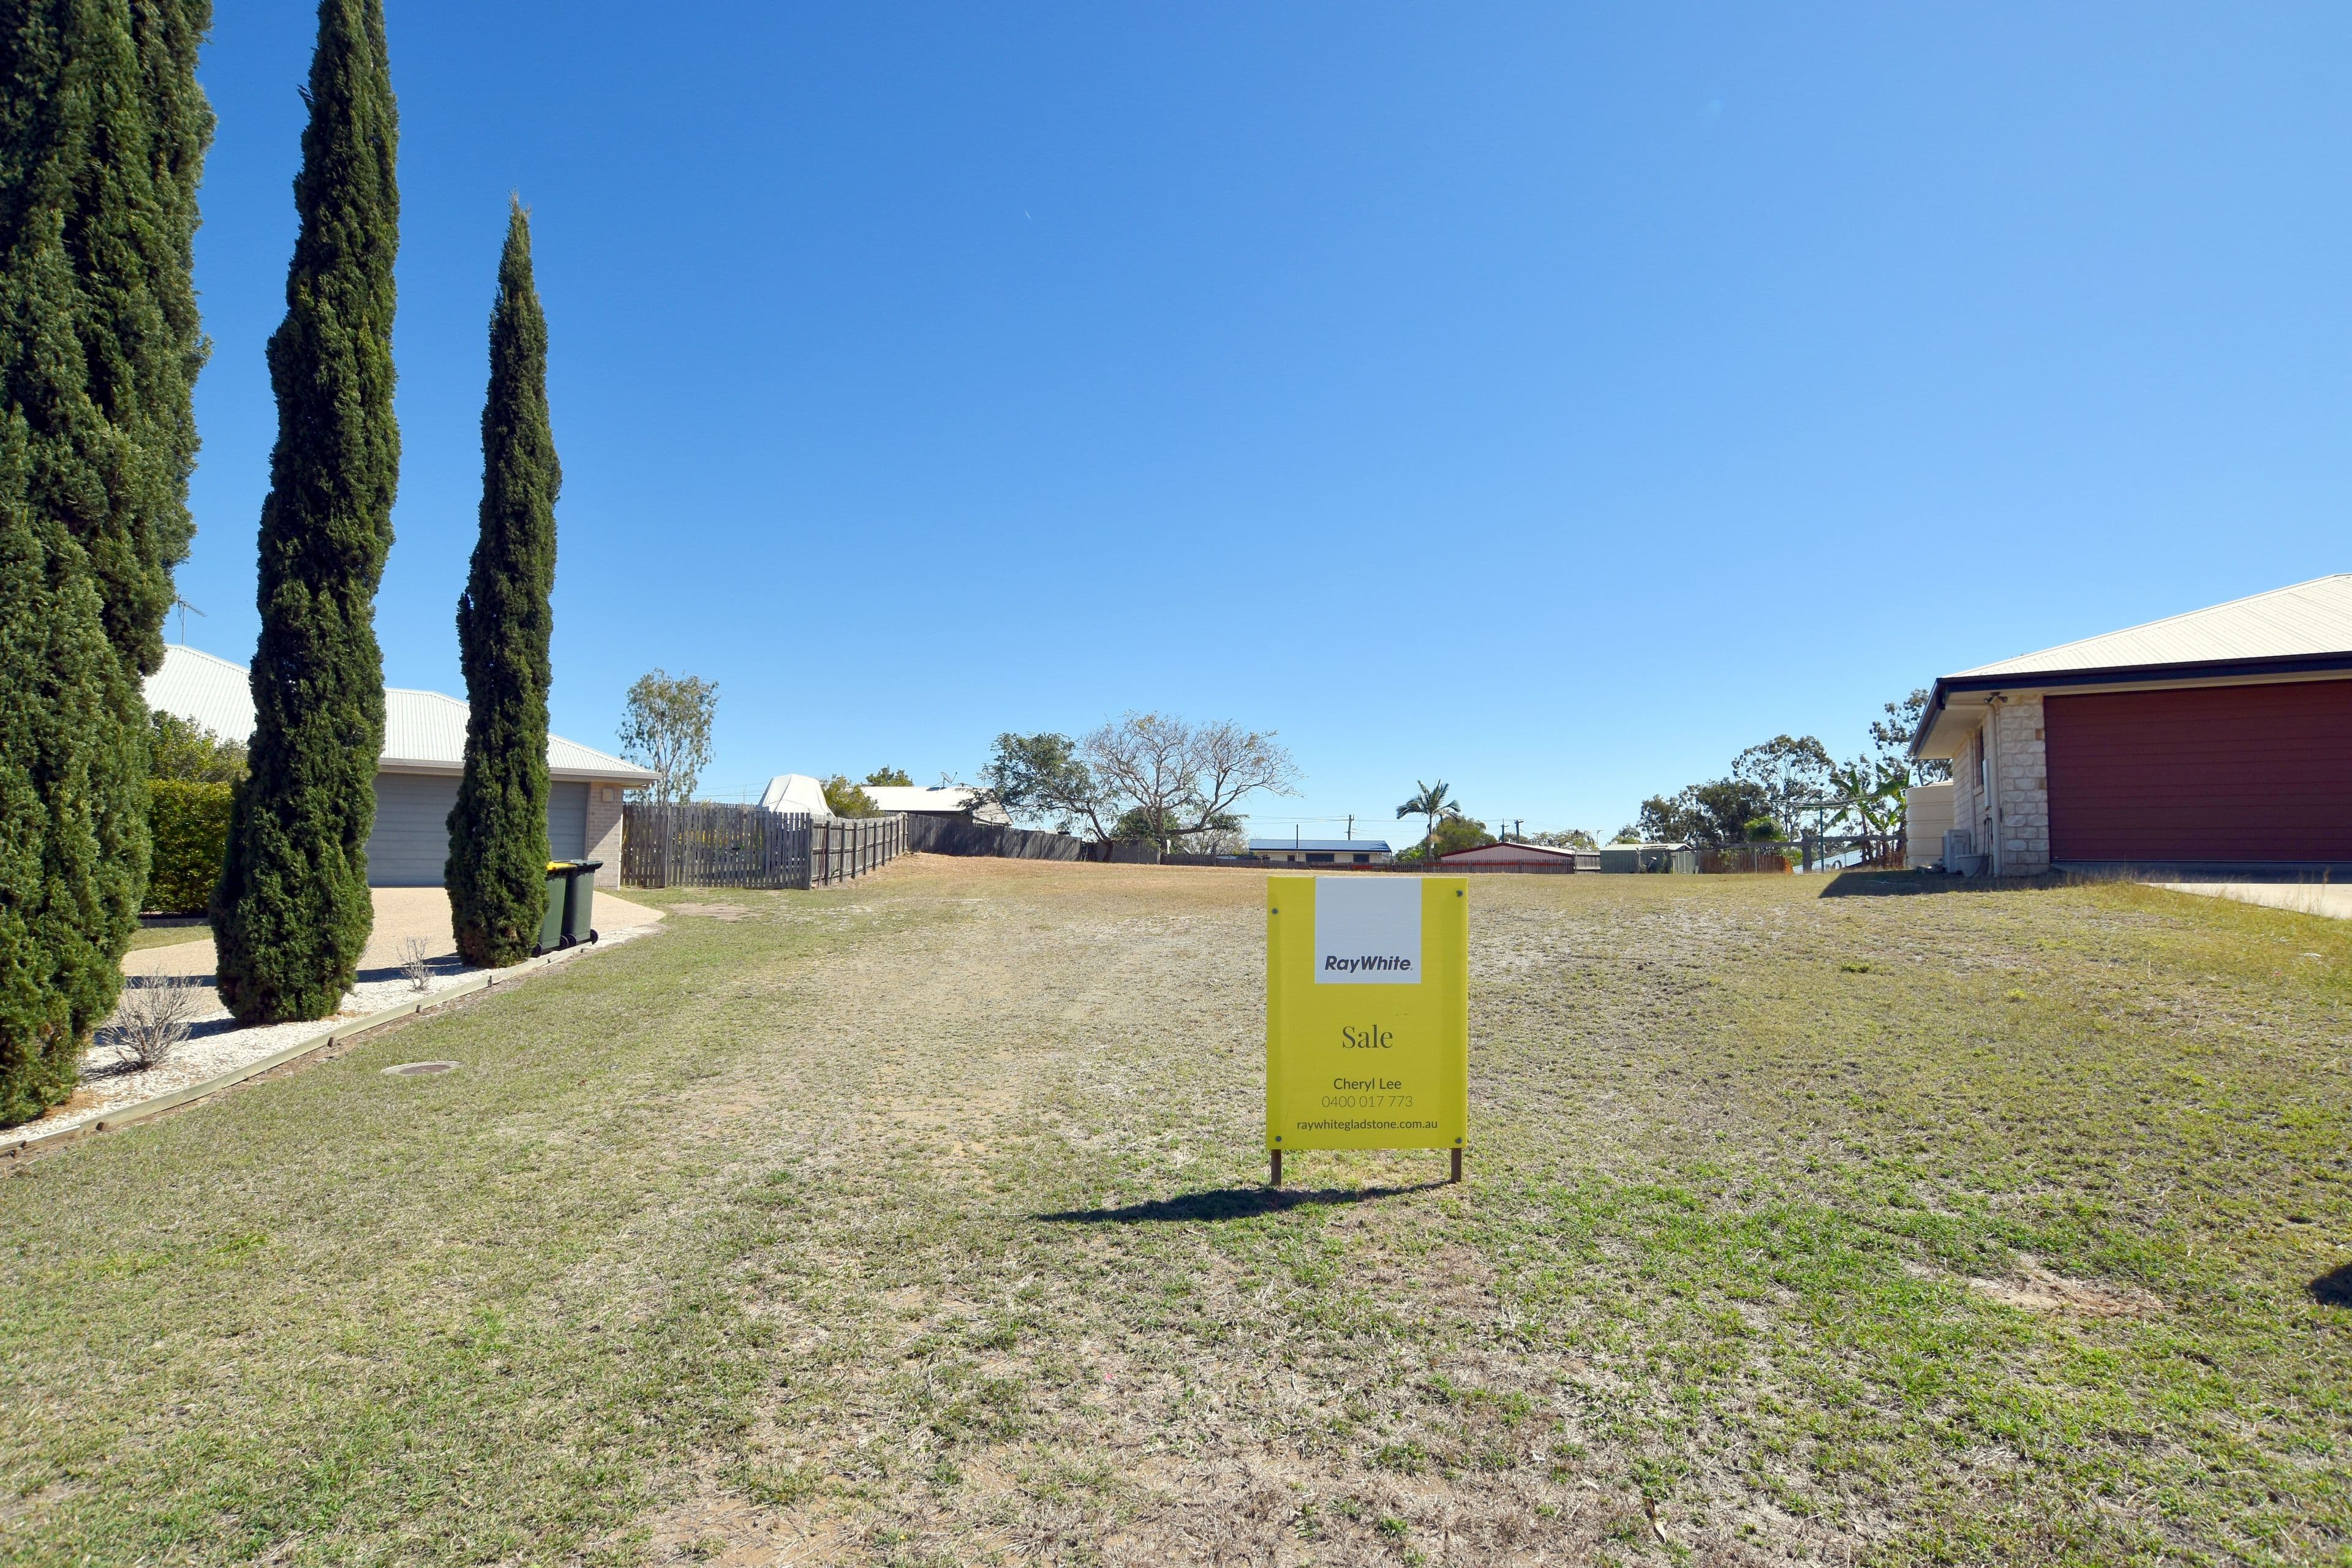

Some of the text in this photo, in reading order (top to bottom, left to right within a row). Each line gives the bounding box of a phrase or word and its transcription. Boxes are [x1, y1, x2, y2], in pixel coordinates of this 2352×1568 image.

[1342, 1024, 1393, 1049] Sale
[1333, 1077, 1402, 1092] Cheryl Lee
[1322, 1095, 1413, 1108] 0400 017 773
[1297, 1119, 1438, 1131] raywhitegladstone.com.au
